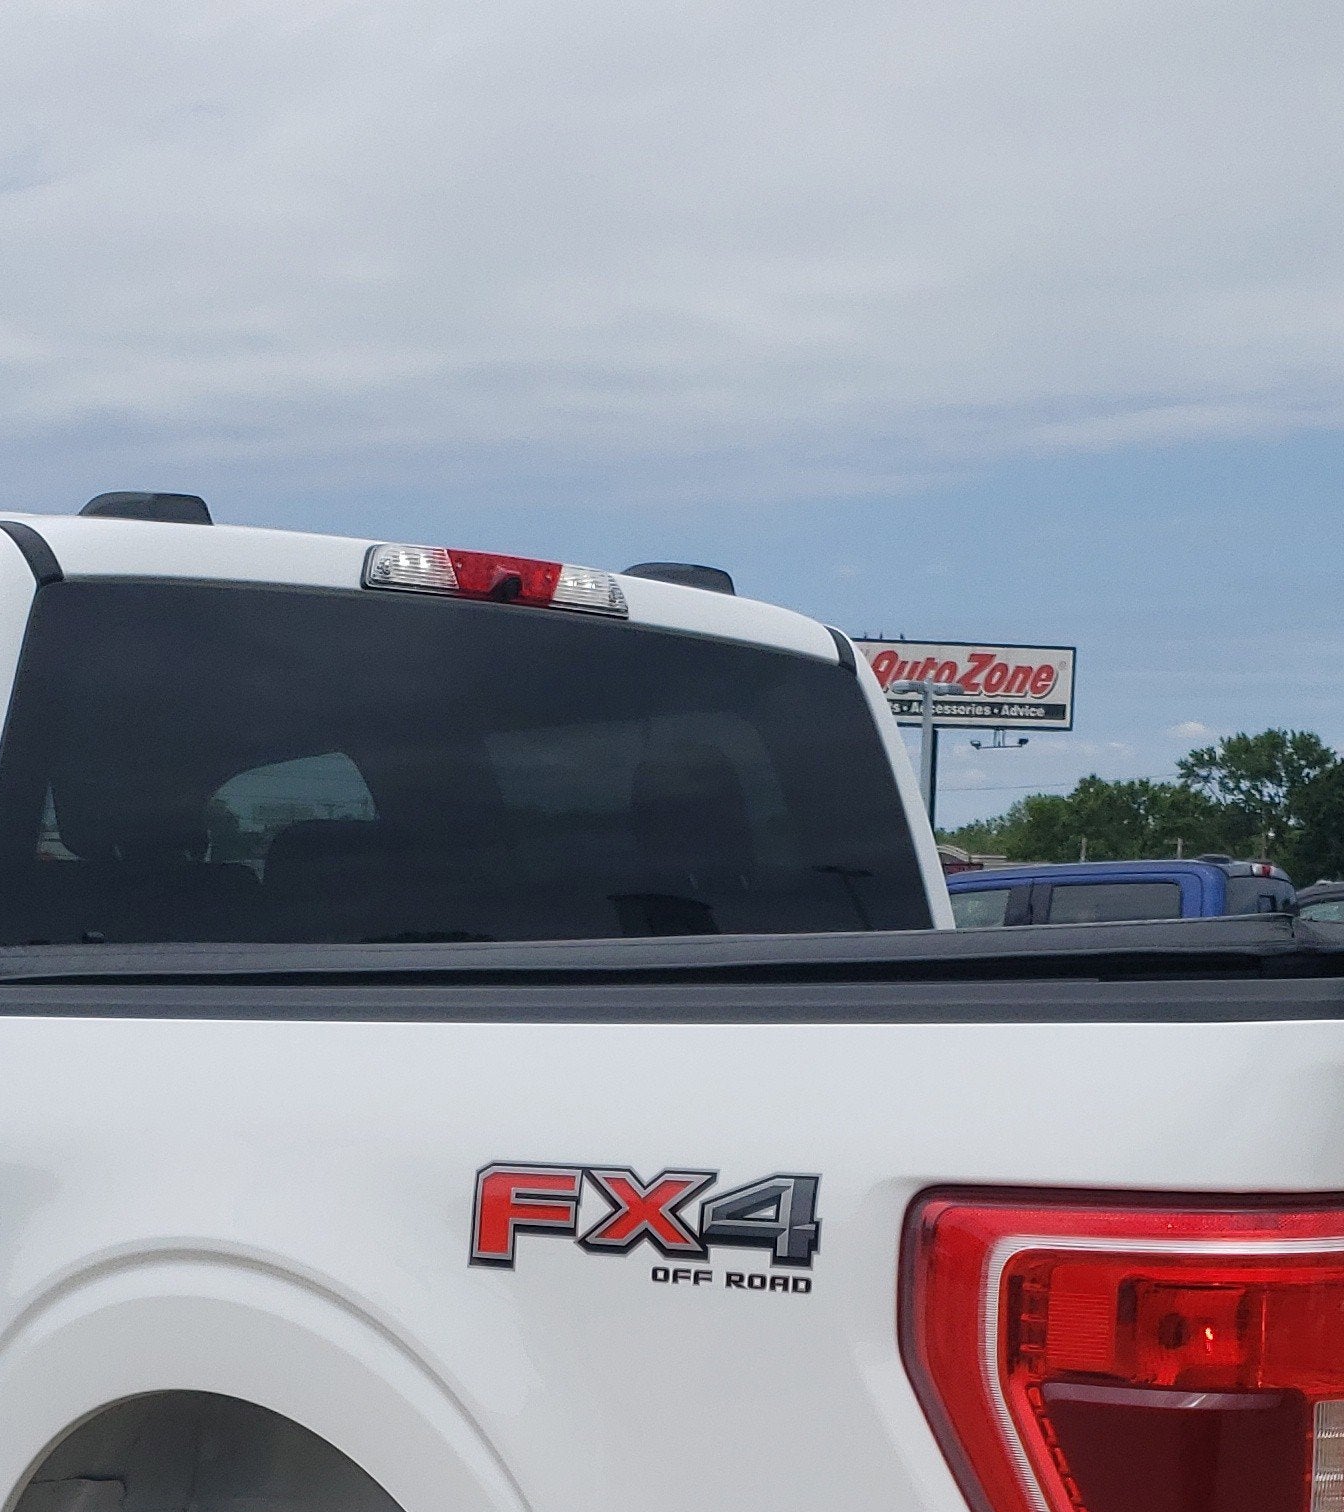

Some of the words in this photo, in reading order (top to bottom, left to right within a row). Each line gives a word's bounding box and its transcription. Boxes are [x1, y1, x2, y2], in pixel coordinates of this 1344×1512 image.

[871, 649, 1056, 697] AutoZone
[910, 702, 992, 716] Aessories
[1001, 704, 1046, 717] Advice
[467, 1160, 823, 1271] FX4
[652, 1266, 713, 1285] OFF
[725, 1271, 813, 1294] ROAD
